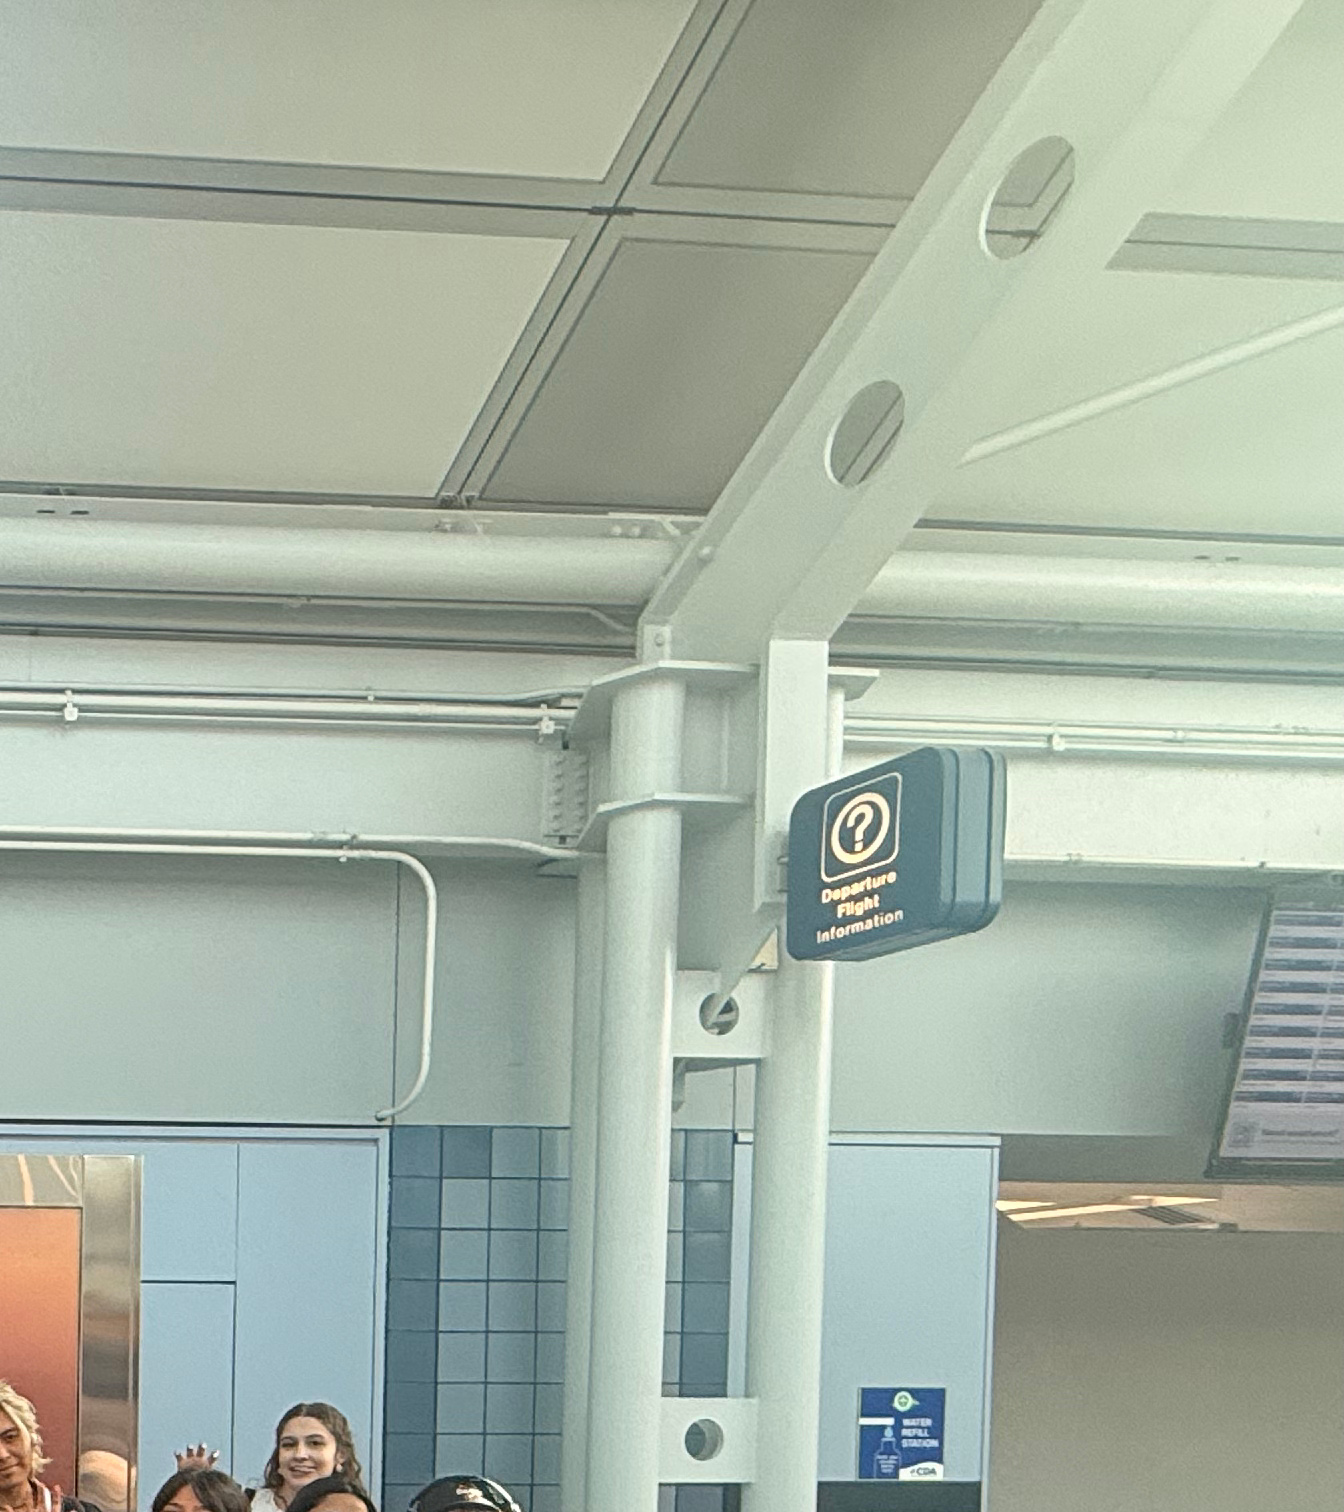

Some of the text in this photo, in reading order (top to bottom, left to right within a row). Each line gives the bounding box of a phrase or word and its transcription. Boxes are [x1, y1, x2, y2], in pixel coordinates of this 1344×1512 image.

[821, 870, 897, 904] Departure
[837, 894, 880, 918] Flight
[816, 908, 904, 944] Information
